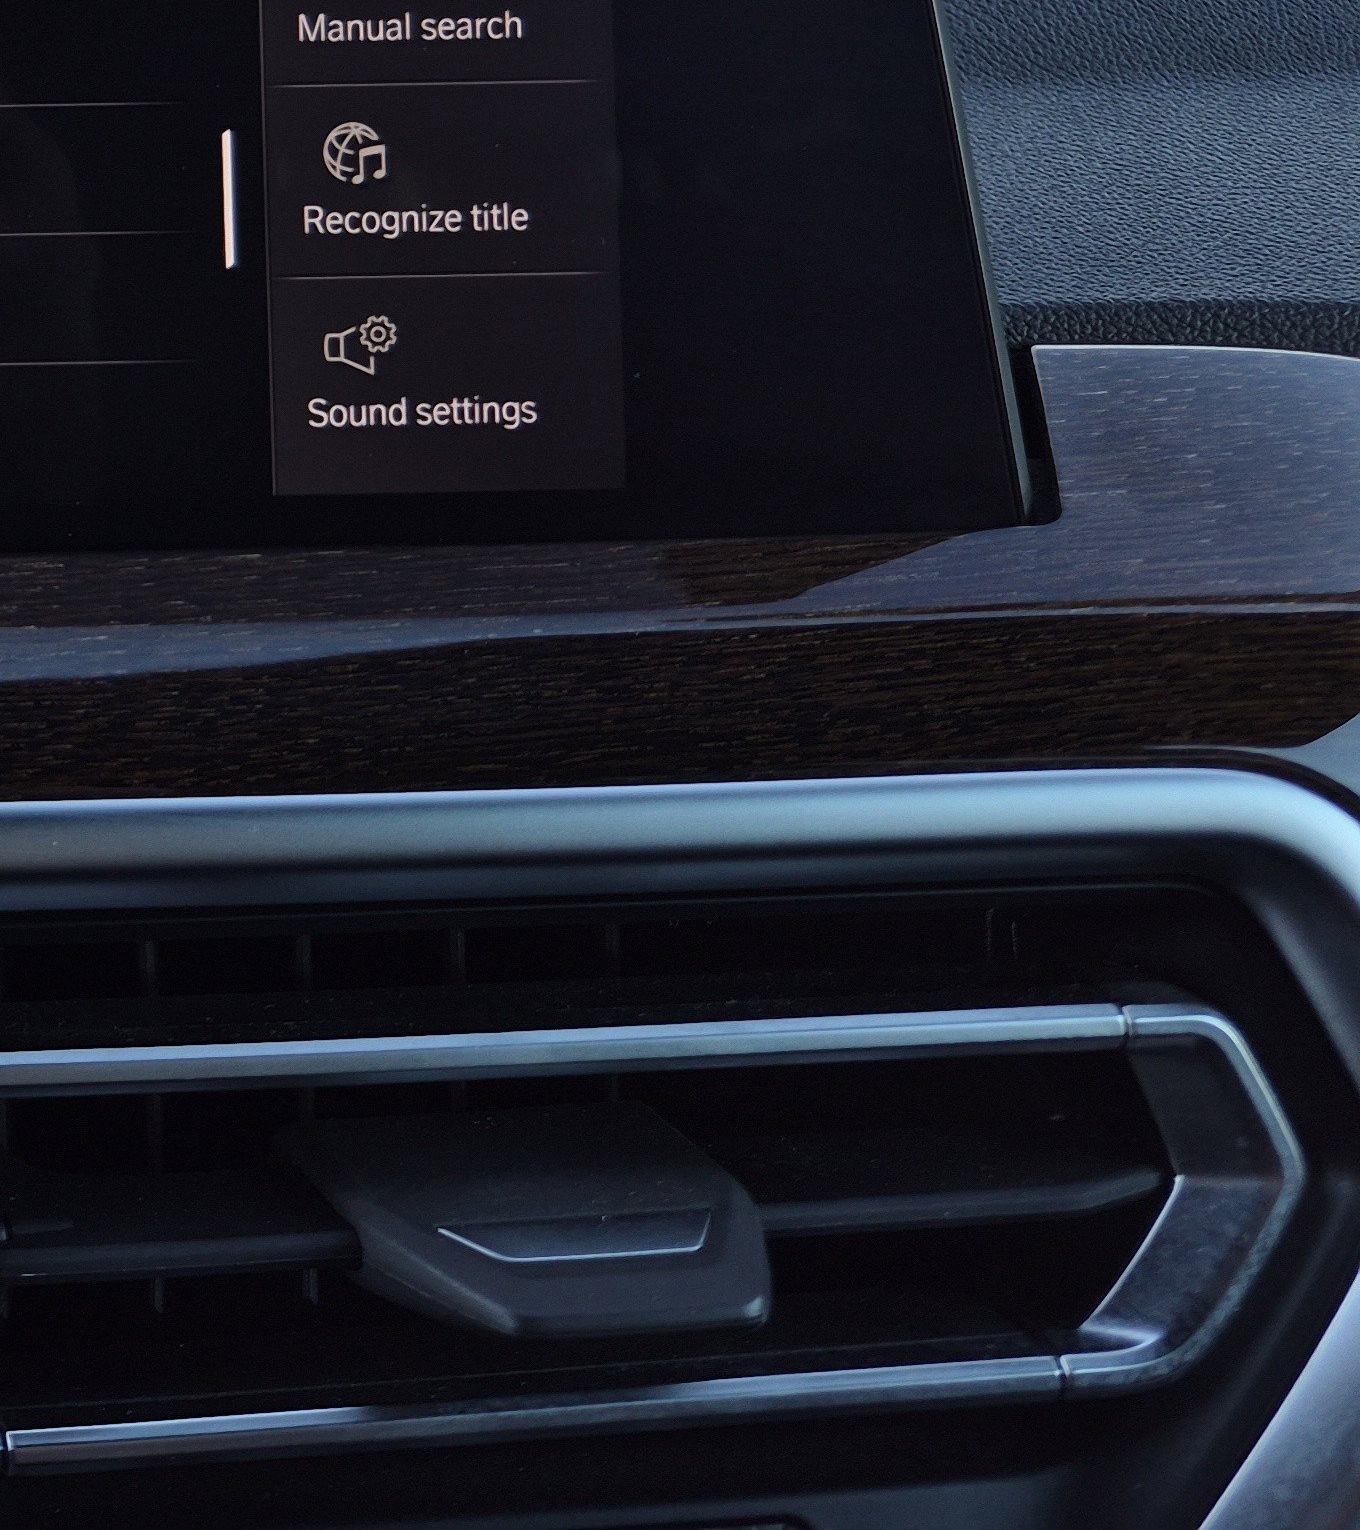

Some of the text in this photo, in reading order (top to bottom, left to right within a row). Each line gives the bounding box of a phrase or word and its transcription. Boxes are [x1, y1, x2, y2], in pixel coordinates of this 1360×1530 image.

[298, 9, 523, 43] Manual search
[303, 201, 529, 240] Recognize title
[307, 395, 538, 430] Sound settings
